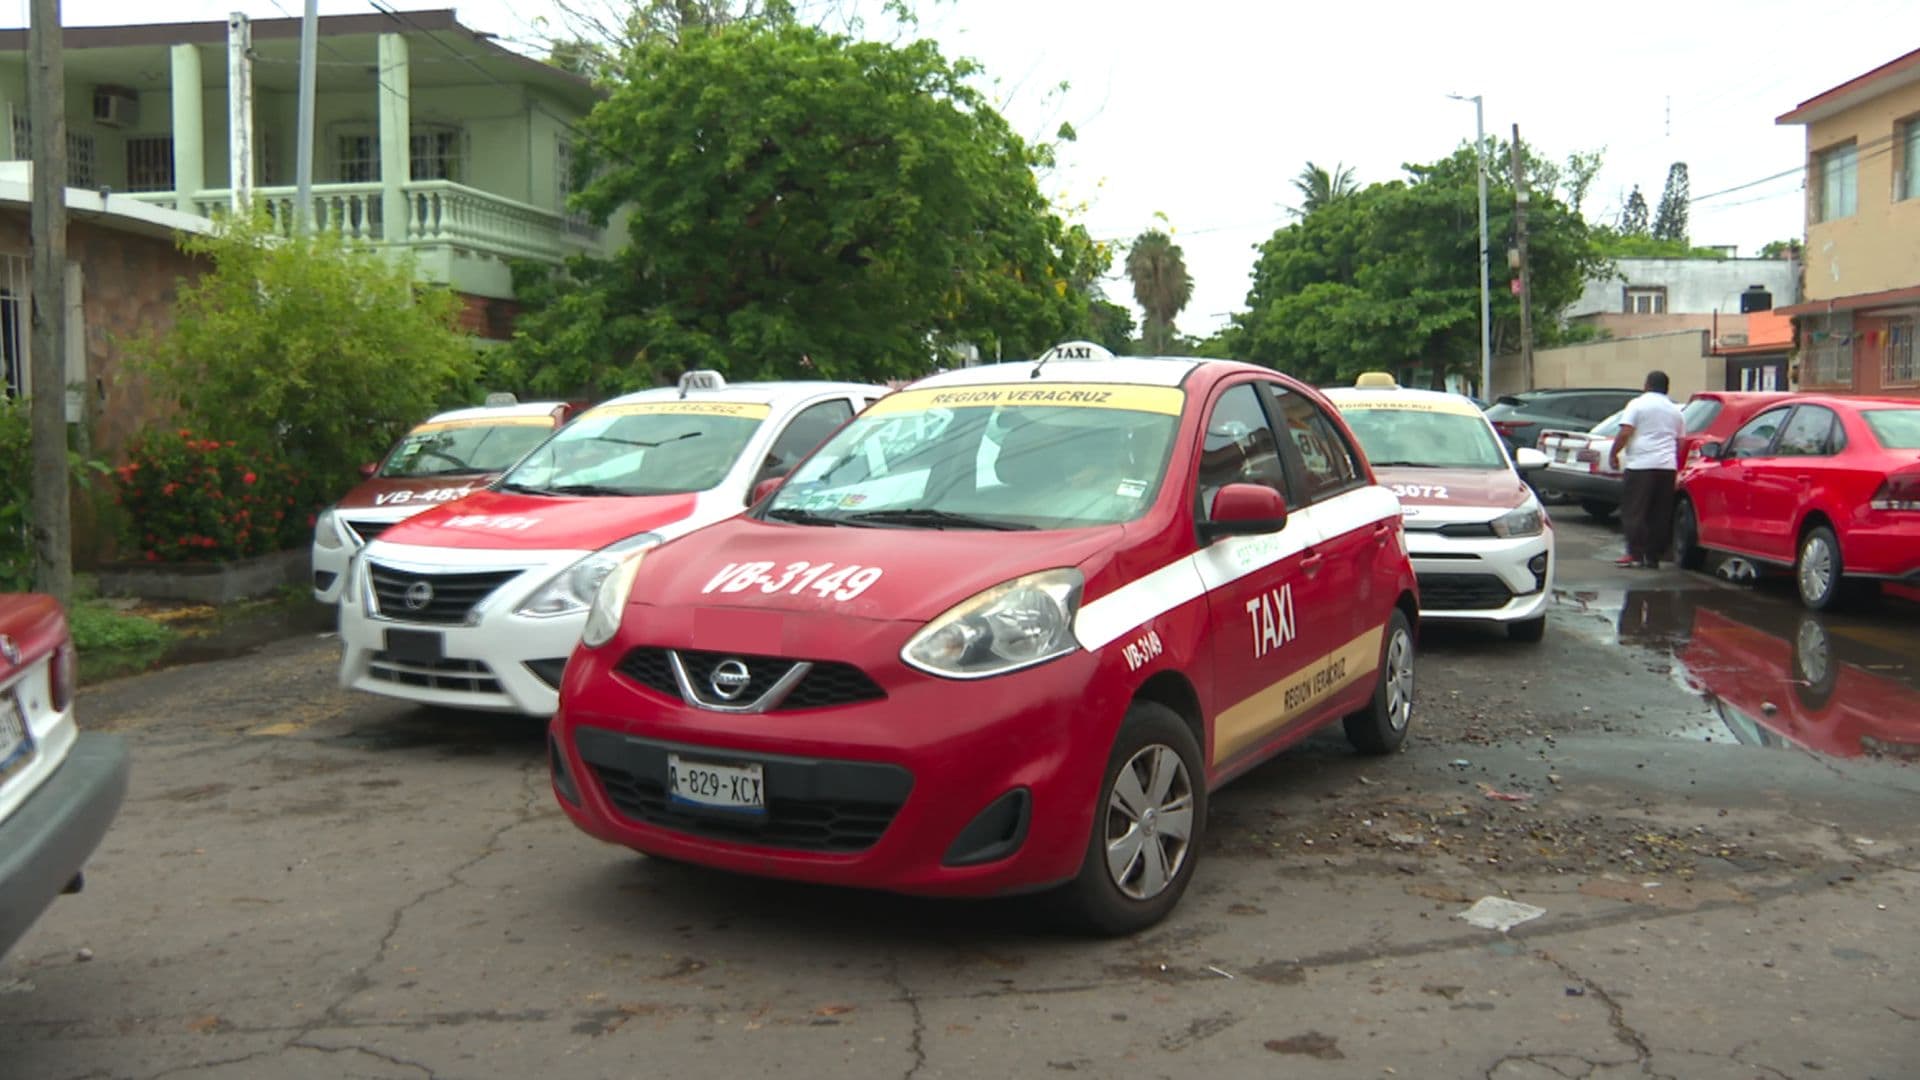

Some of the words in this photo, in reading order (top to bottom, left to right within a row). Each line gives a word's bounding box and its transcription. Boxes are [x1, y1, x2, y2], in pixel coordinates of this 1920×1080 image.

[1056, 347, 1091, 359] TAXI
[931, 391, 1002, 404] REGION
[1007, 390, 1112, 403] VERACRUZ
[1392, 484, 1449, 499] 3072
[700, 561, 883, 602] VB-3149
[1246, 583, 1296, 659] TAXI
[1121, 629, 1163, 672] VB-3149
[1284, 678, 1312, 712] REGION
[1312, 656, 1346, 696] VERACRUZ
[669, 765, 762, 805] A-829-XCX
